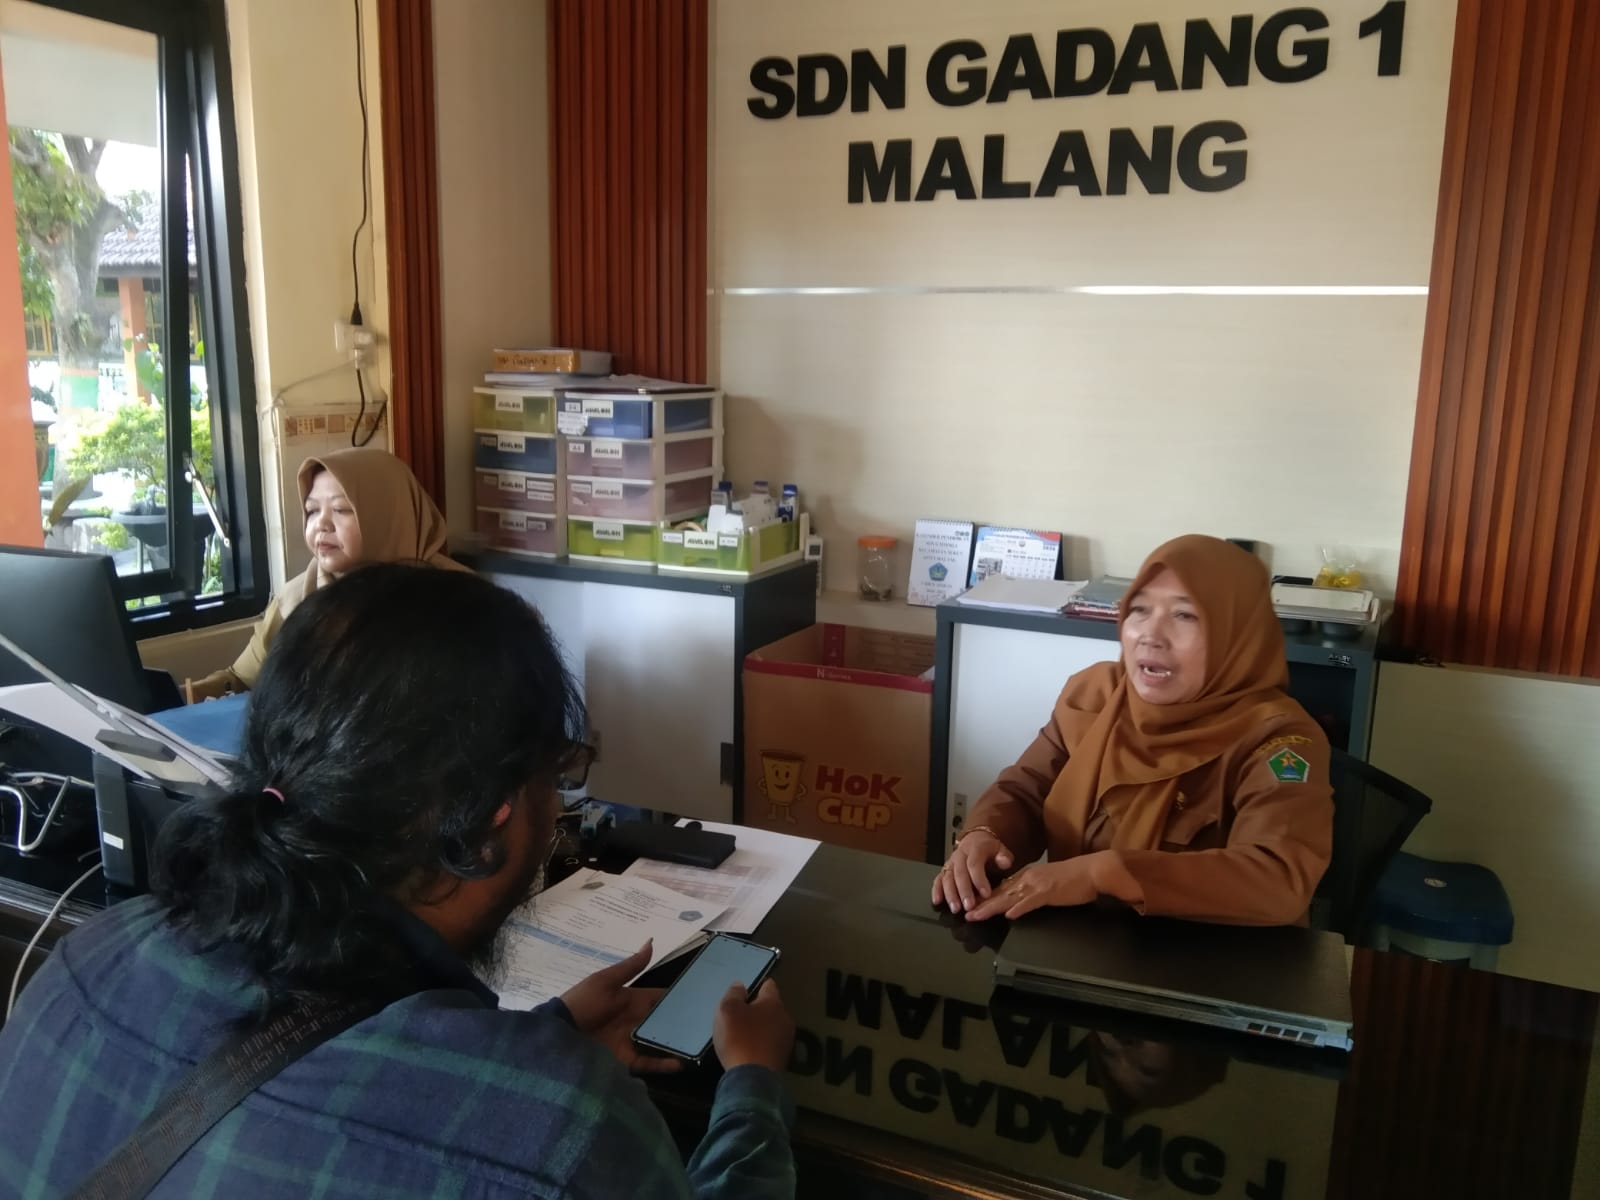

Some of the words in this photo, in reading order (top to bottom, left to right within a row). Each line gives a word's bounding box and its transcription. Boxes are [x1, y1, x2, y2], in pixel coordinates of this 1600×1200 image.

[747, 44, 906, 119] SDN
[926, 7, 1329, 107] GADANG
[1358, 0, 1405, 77] 1
[848, 120, 1248, 204] MALANG
